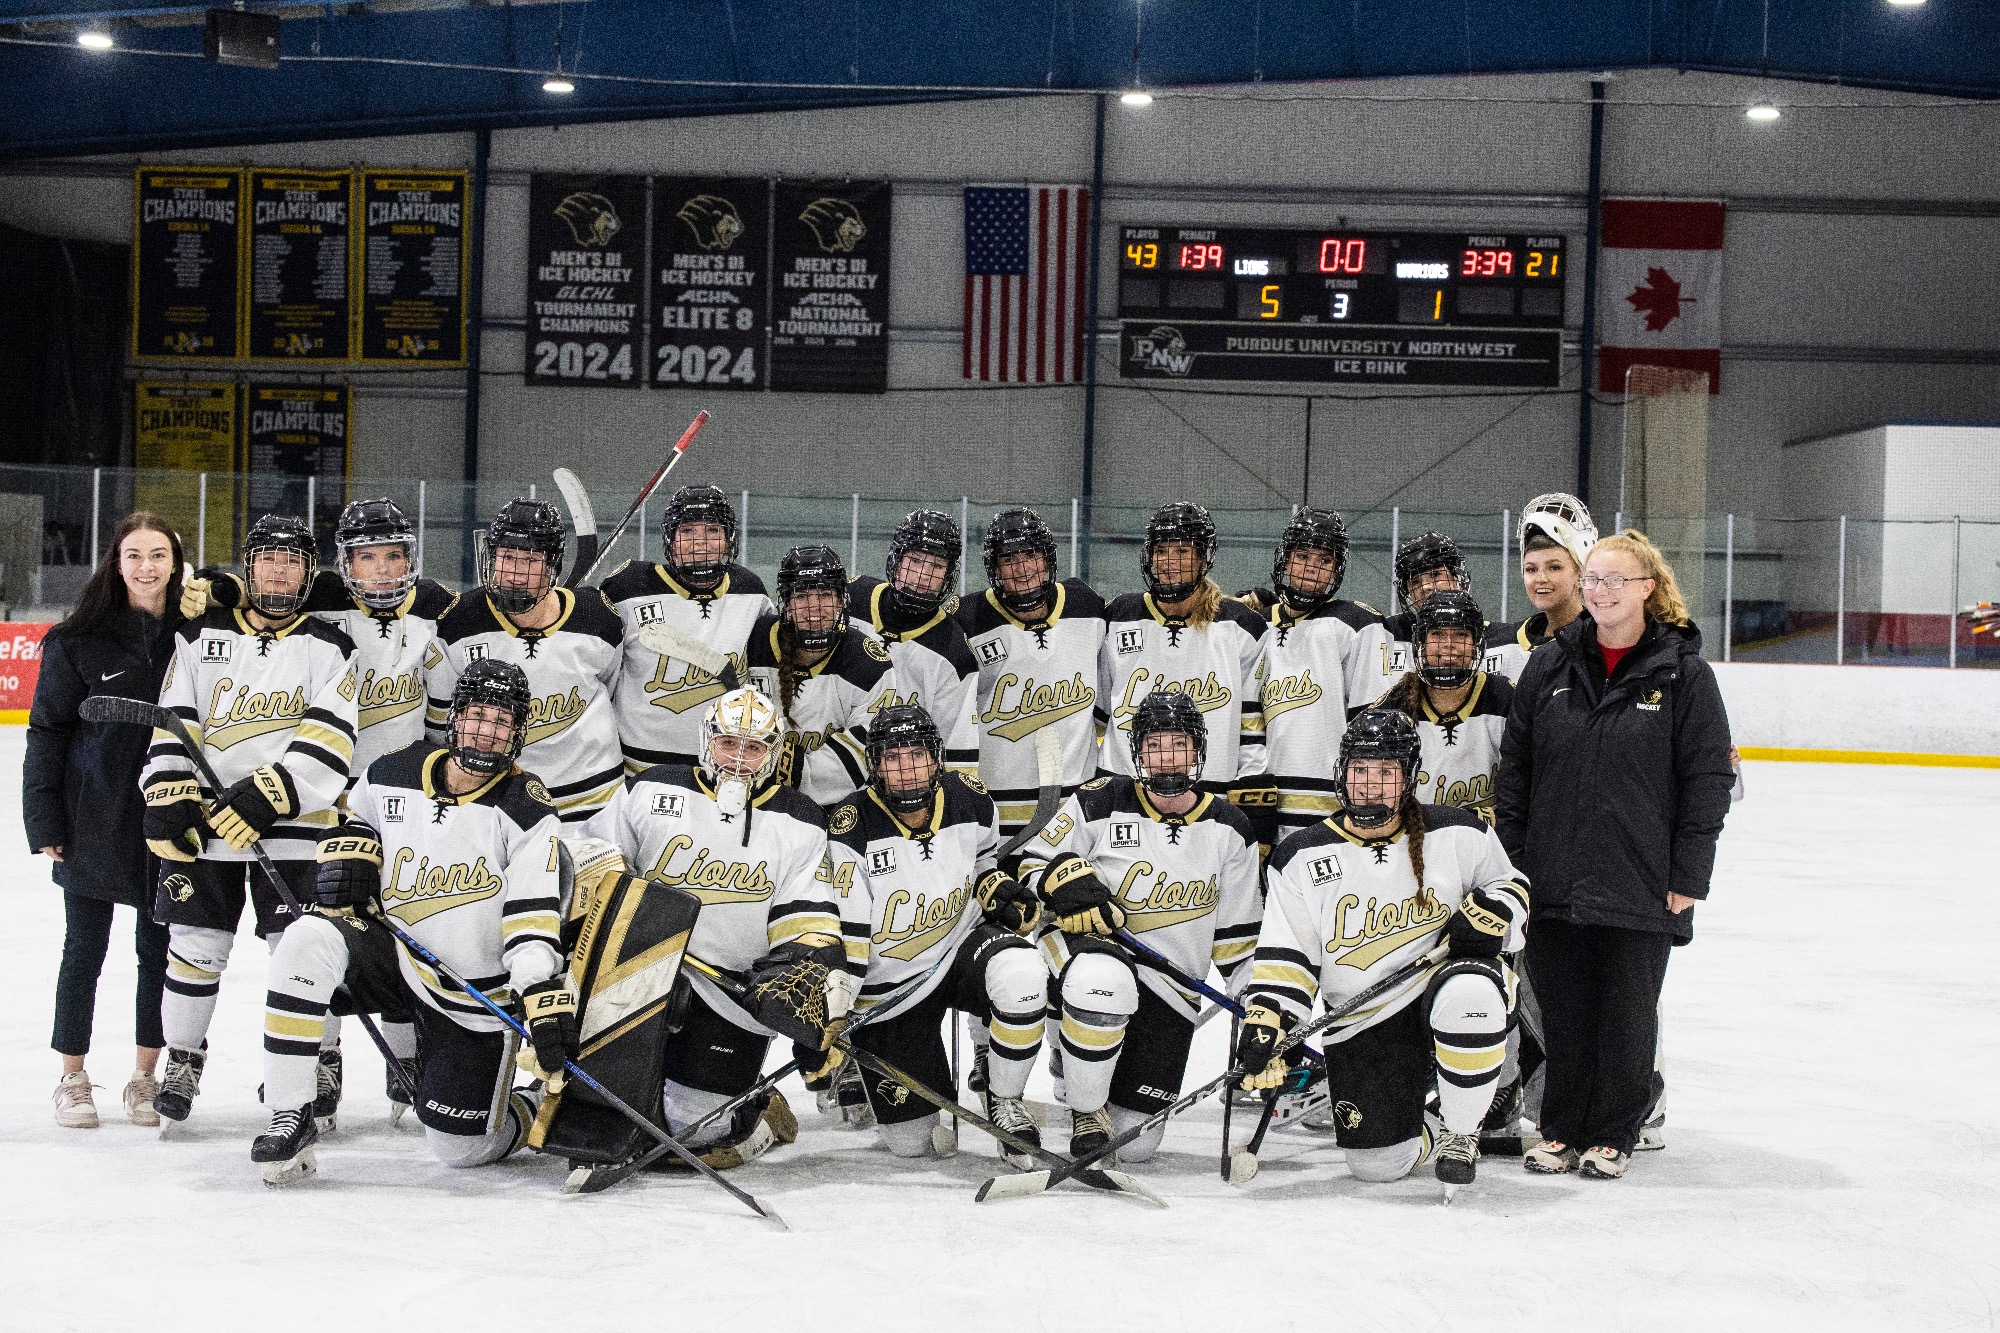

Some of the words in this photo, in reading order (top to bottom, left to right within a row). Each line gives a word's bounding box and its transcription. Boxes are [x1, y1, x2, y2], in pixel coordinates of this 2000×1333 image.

[144, 198, 236, 225] CHAMPIONS
[255, 200, 346, 226] CHAMPIONS
[368, 201, 461, 227] CHAMPIONS
[1126, 229, 1159, 240] PLAYER
[1178, 230, 1217, 241] PENALTY
[1467, 236, 1507, 248] PENALTY
[1526, 238, 1560, 248] PLAYER
[1127, 243, 1158, 268] 43
[1180, 245, 1223, 269] 1:39
[1462, 251, 1513, 276] 3:39
[1525, 252, 1559, 277] 21
[538, 267, 565, 281] ICE
[568, 268, 632, 283] HOCKEY
[1234, 259, 1269, 275] LIONS
[661, 270, 688, 285] ICE
[691, 271, 755, 287] HOCKEY
[783, 272, 810, 288] ICE
[813, 273, 878, 289] HOCKEY
[534, 301, 636, 318] TOURNAMENT
[1260, 285, 1280, 318] 5
[1333, 293, 1349, 318] 3
[1433, 290, 1443, 320] 1
[662, 306, 730, 330] ELITE
[736, 308, 754, 331] 8
[790, 307, 870, 321] NATIONAL
[540, 318, 630, 334] CHAMPIONS
[777, 320, 883, 336] TOURNAMENT
[1132, 337, 1194, 374] PNW
[1226, 337, 1294, 351] PURDUE
[1298, 338, 1403, 355] UNIVERSITY
[1408, 341, 1516, 357] NORTHWEST
[534, 342, 634, 381] 2024
[657, 345, 756, 383] 2024
[1333, 360, 1361, 374] ICE
[1365, 360, 1407, 375] RINK
[141, 408, 230, 434] CHAMPIONS
[798, 568, 823, 576] CCM
[640, 604, 656, 621] ET
[207, 640, 225, 656] ET
[1121, 631, 1137, 648] ET
[982, 641, 1000, 659] ET
[1486, 656, 1498, 672] ET
[358, 667, 423, 707] ions
[203, 677, 310, 733] Lions
[526, 685, 587, 725] ons
[982, 671, 1095, 724] Lions
[1636, 702, 1662, 711] HOCKEY
[890, 723, 916, 733] CCM
[256, 766, 283, 803] UER
[387, 798, 401, 814] ET
[658, 795, 677, 809] ET
[1238, 790, 1277, 805] CC
[1040, 813, 1075, 846] 3
[1115, 824, 1133, 840] ET
[323, 840, 384, 858] BAUE
[1112, 839, 1138, 847] SPORTS
[645, 833, 774, 894] Lions
[873, 850, 890, 868] ET
[1313, 858, 1333, 877] ET
[381, 846, 503, 900] Lions
[833, 861, 857, 898] 4
[1113, 860, 1220, 912] Lions
[871, 873, 974, 945] Lions
[1461, 898, 1506, 933] AUER
[1325, 887, 1451, 954] Lions
[396, 929, 437, 963] CCM
[1136, 1084, 1180, 1103] BAUE
[425, 1099, 490, 1120] BAUER
